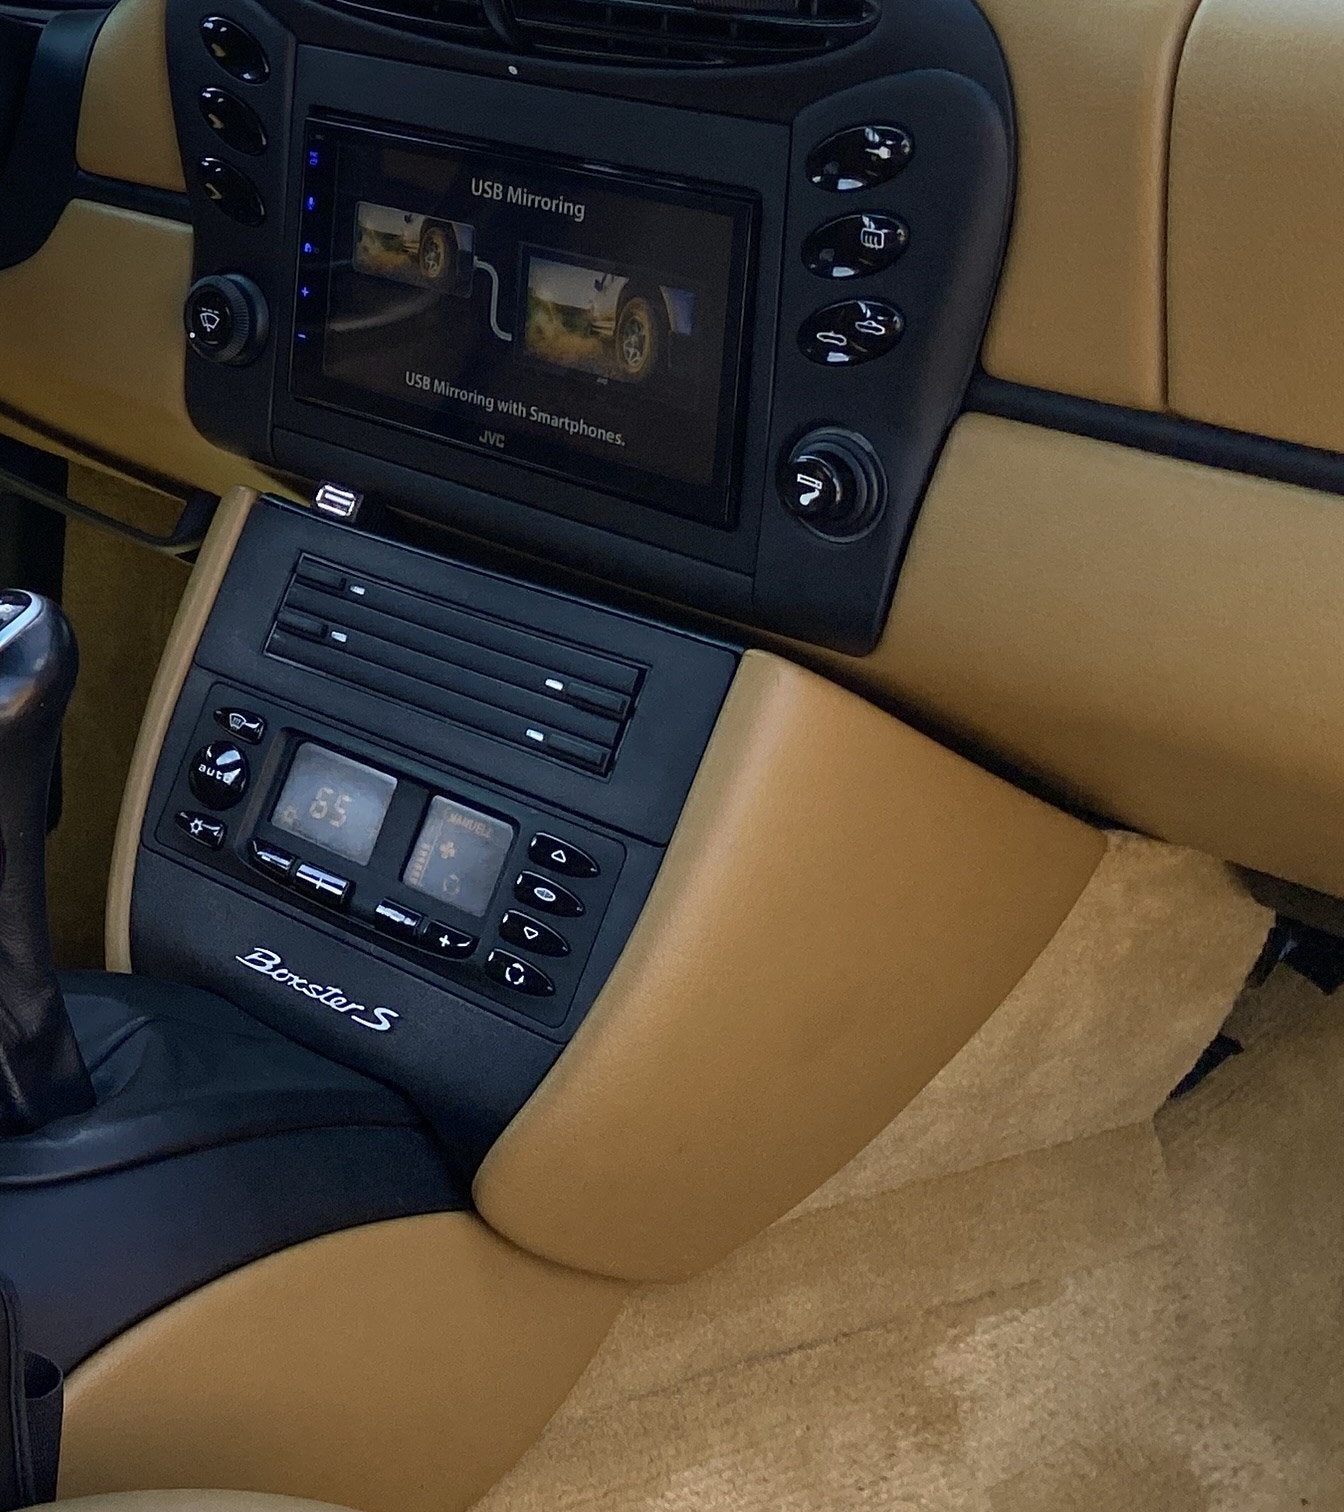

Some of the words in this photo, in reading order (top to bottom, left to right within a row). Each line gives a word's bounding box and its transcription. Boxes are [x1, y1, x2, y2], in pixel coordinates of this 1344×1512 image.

[471, 177, 503, 201] USB
[507, 185, 586, 223] Mirroring
[405, 370, 431, 391] USB
[433, 378, 495, 412] Mirroring
[497, 399, 527, 418] with
[529, 406, 626, 447] Smartphones.
[478, 429, 506, 449] JVC
[235, 947, 365, 1013] Boxster
[351, 1007, 400, 1031] S
